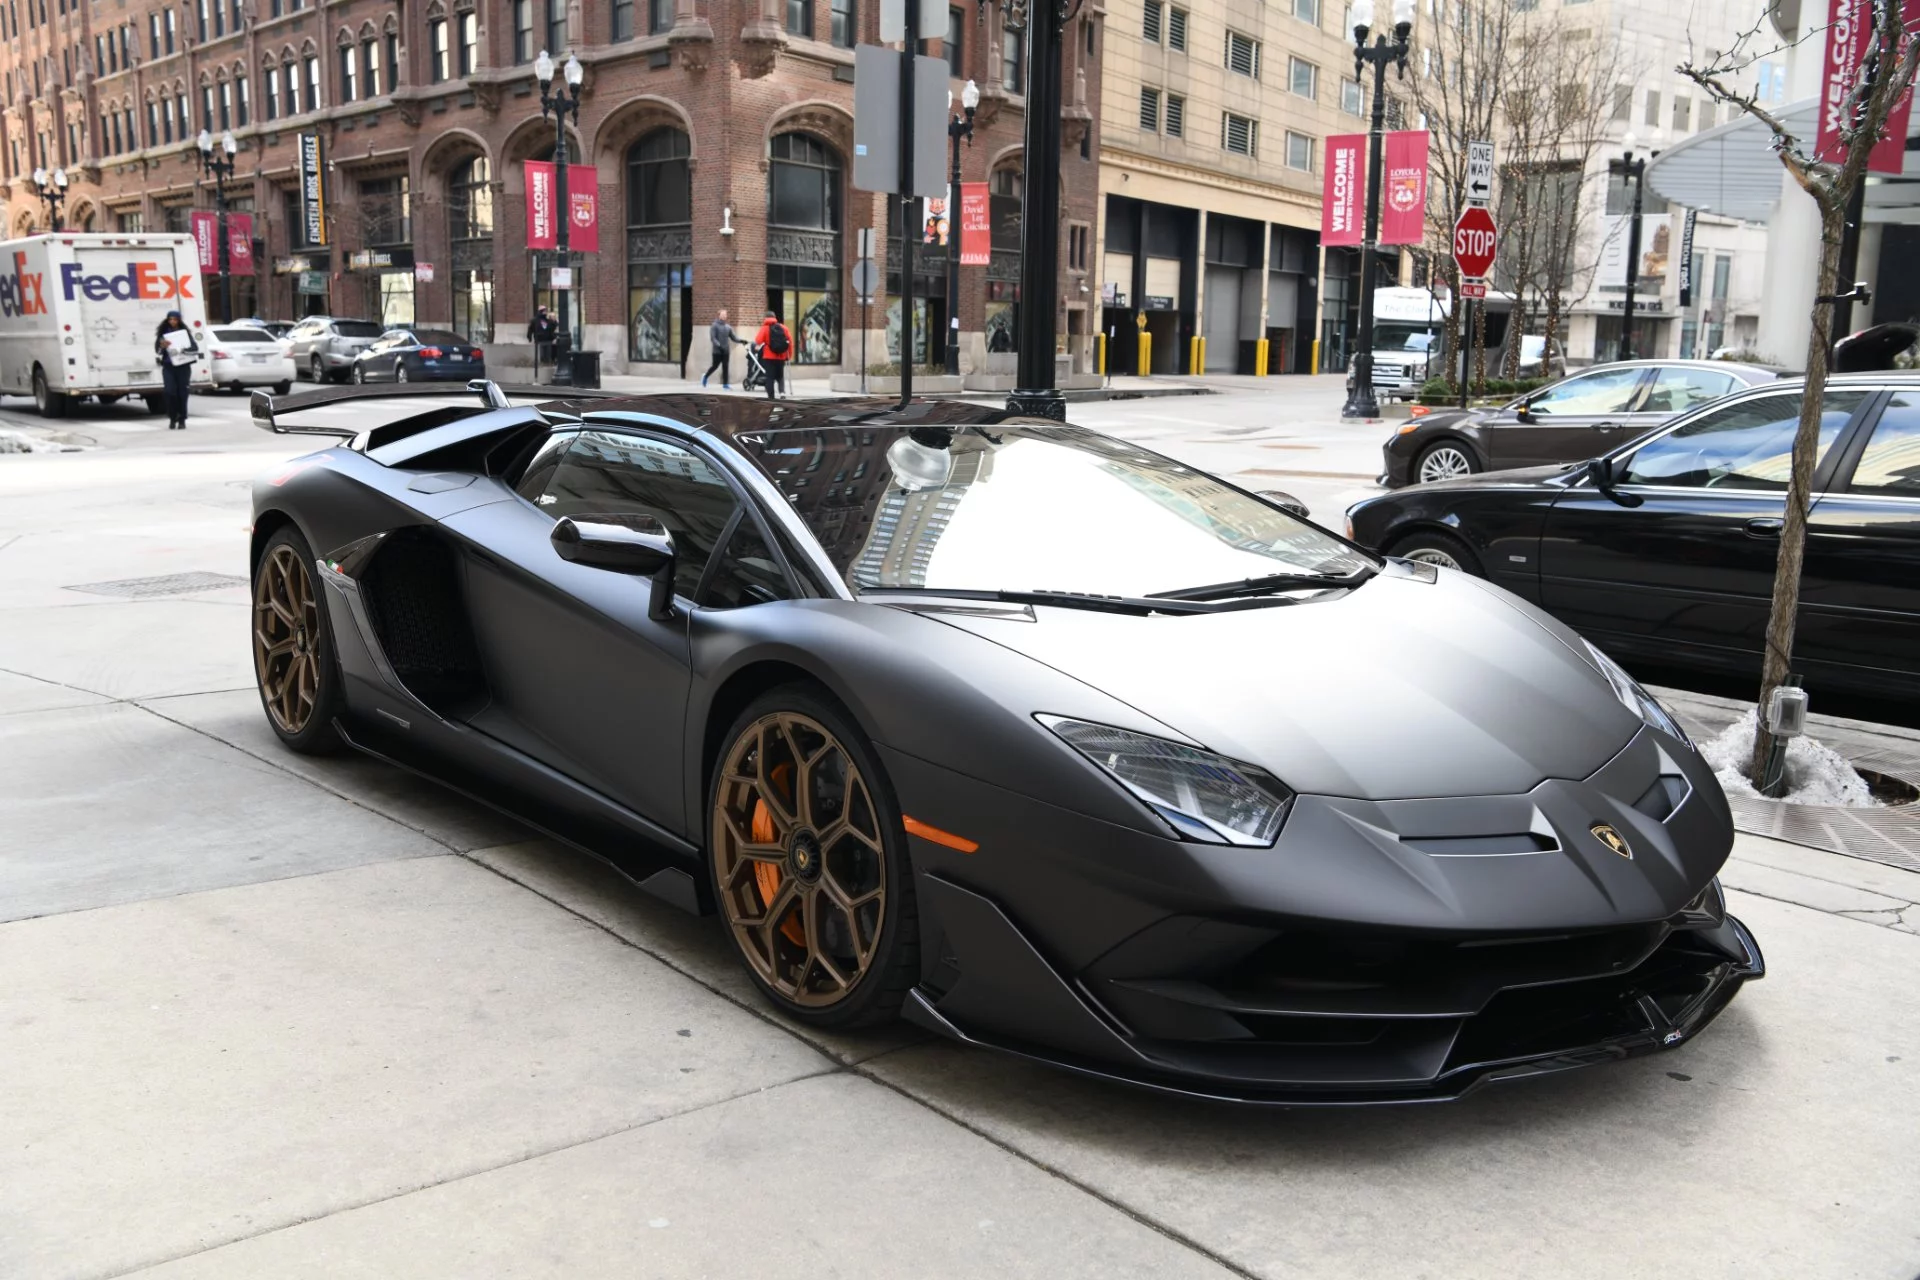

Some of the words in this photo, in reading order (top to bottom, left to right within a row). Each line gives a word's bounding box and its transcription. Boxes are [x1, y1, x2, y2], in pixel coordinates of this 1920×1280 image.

[1825, 0, 1850, 133] WELCOM
[305, 136, 318, 172] BAGELS
[1348, 148, 1356, 180] CAMPUS
[1471, 147, 1491, 162] ONE
[1390, 167, 1422, 177] LOYOLA
[1470, 164, 1491, 177] WAY
[532, 171, 545, 238] WELCOME
[1332, 148, 1348, 232] WELCOME
[1347, 181, 1355, 206] TOWER
[308, 201, 321, 243] EINSTEIN
[963, 204, 984, 214] David
[1345, 208, 1353, 232] WATER
[197, 219, 208, 266] WELCOME
[1456, 228, 1495, 257] STOP
[1682, 209, 1696, 265] NORDSTROM
[0, 250, 47, 318] edEx
[59, 262, 195, 301] FedEx
[1462, 285, 1473, 295] ALL
[1473, 286, 1485, 296] WAY
[1680, 265, 1691, 291] rack
